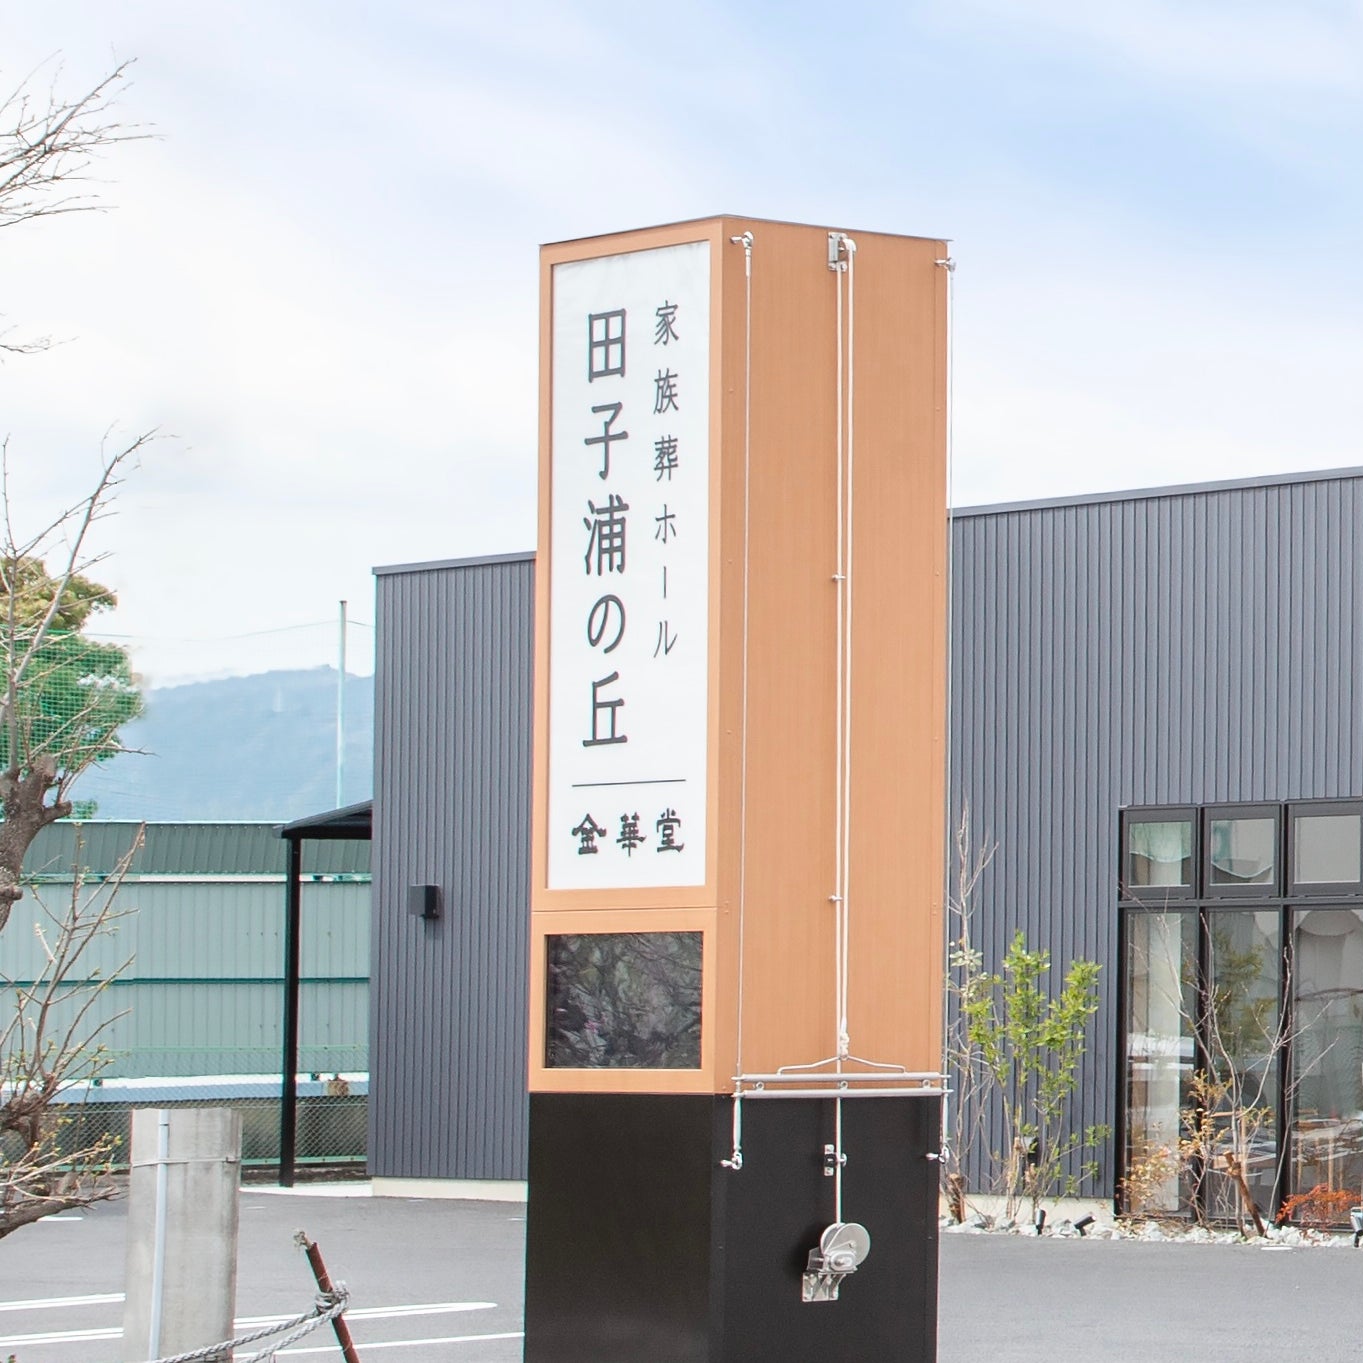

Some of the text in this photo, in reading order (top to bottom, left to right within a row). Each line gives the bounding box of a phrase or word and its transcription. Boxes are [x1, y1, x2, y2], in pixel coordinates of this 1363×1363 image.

[581, 307, 631, 749] 田子浦の丘
[653, 299, 680, 659] 家族葬ホール
[570, 806, 686, 858] 金華堂
